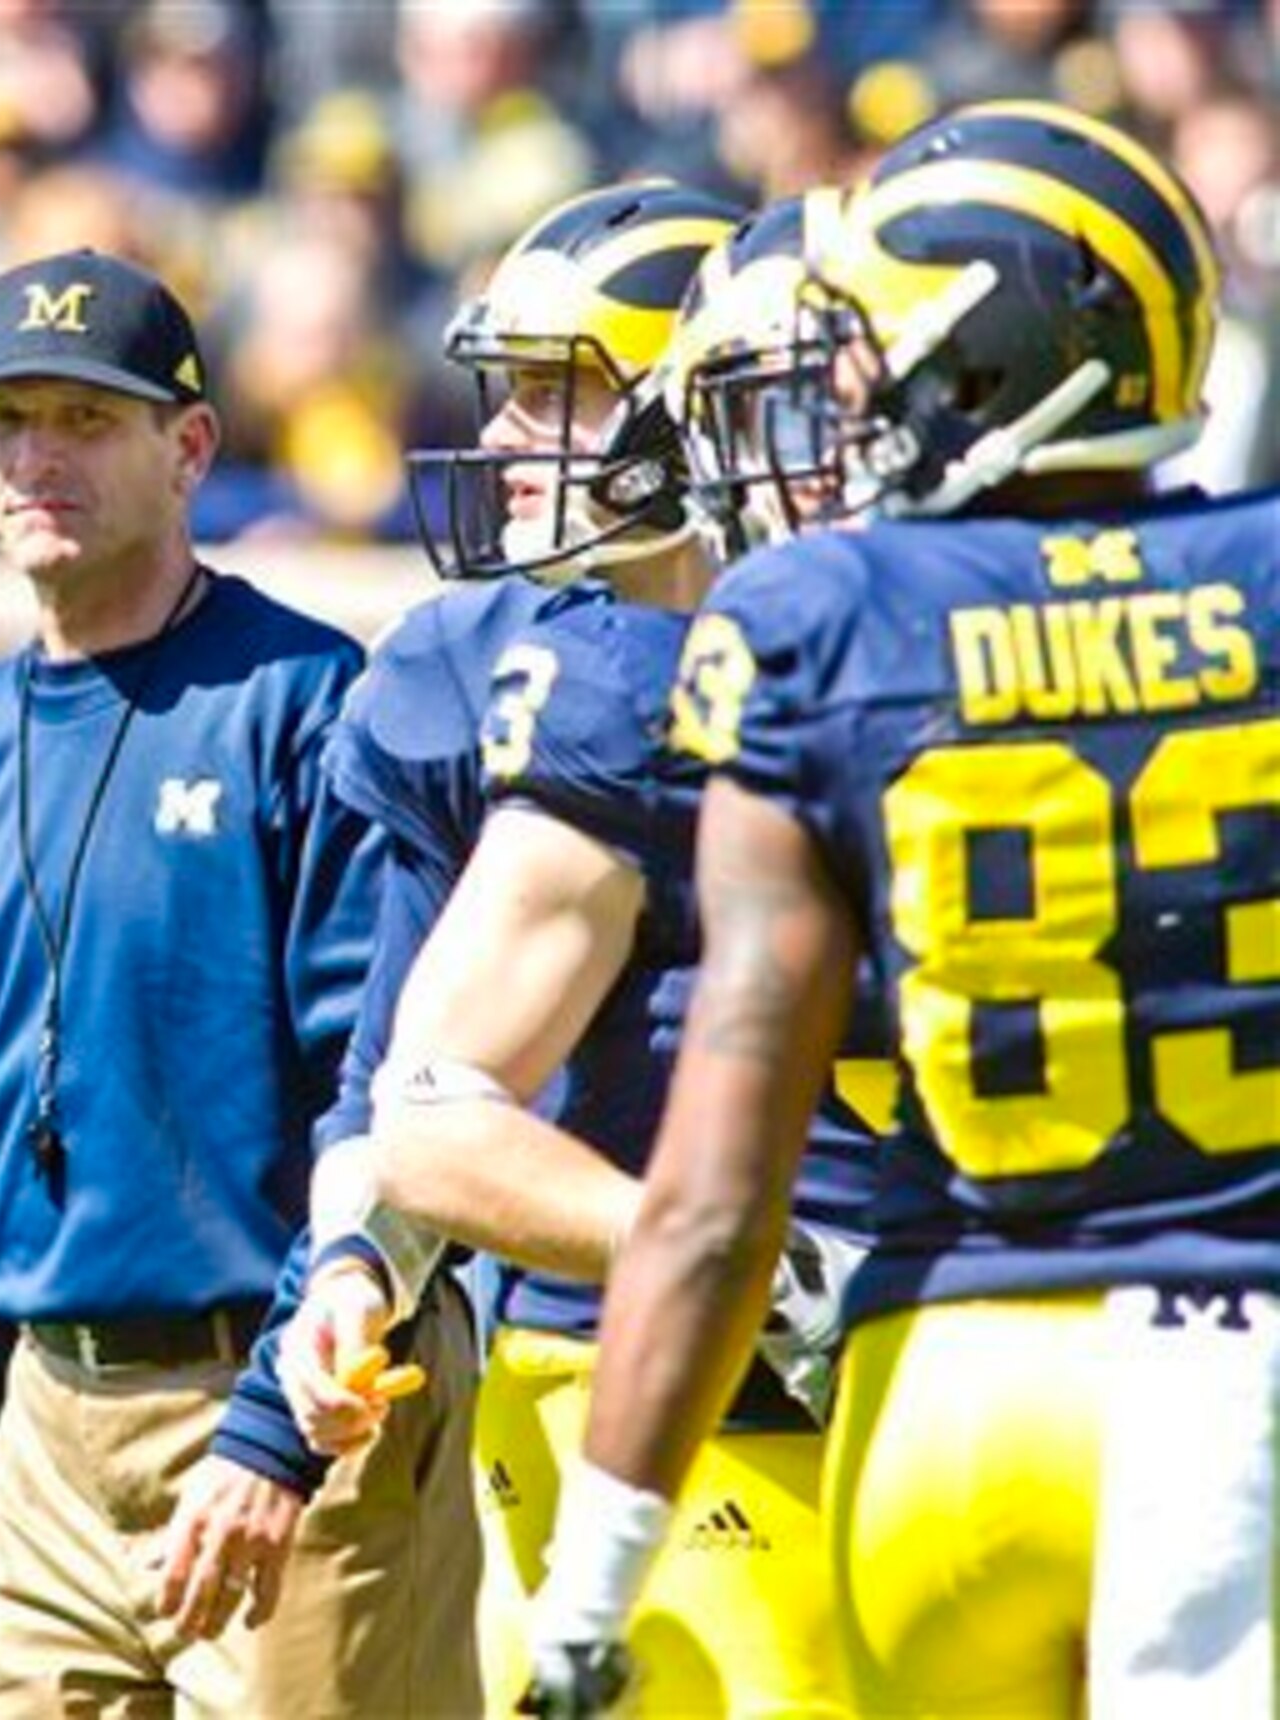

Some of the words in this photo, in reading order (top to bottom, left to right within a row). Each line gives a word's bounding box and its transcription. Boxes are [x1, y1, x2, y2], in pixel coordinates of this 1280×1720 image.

[18, 283, 91, 332] M
[1039, 530, 1143, 586] M
[949, 583, 1257, 724] DUKES
[480, 643, 558, 777] 3
[155, 778, 222, 835] M
[883, 718, 1280, 1180] 83
